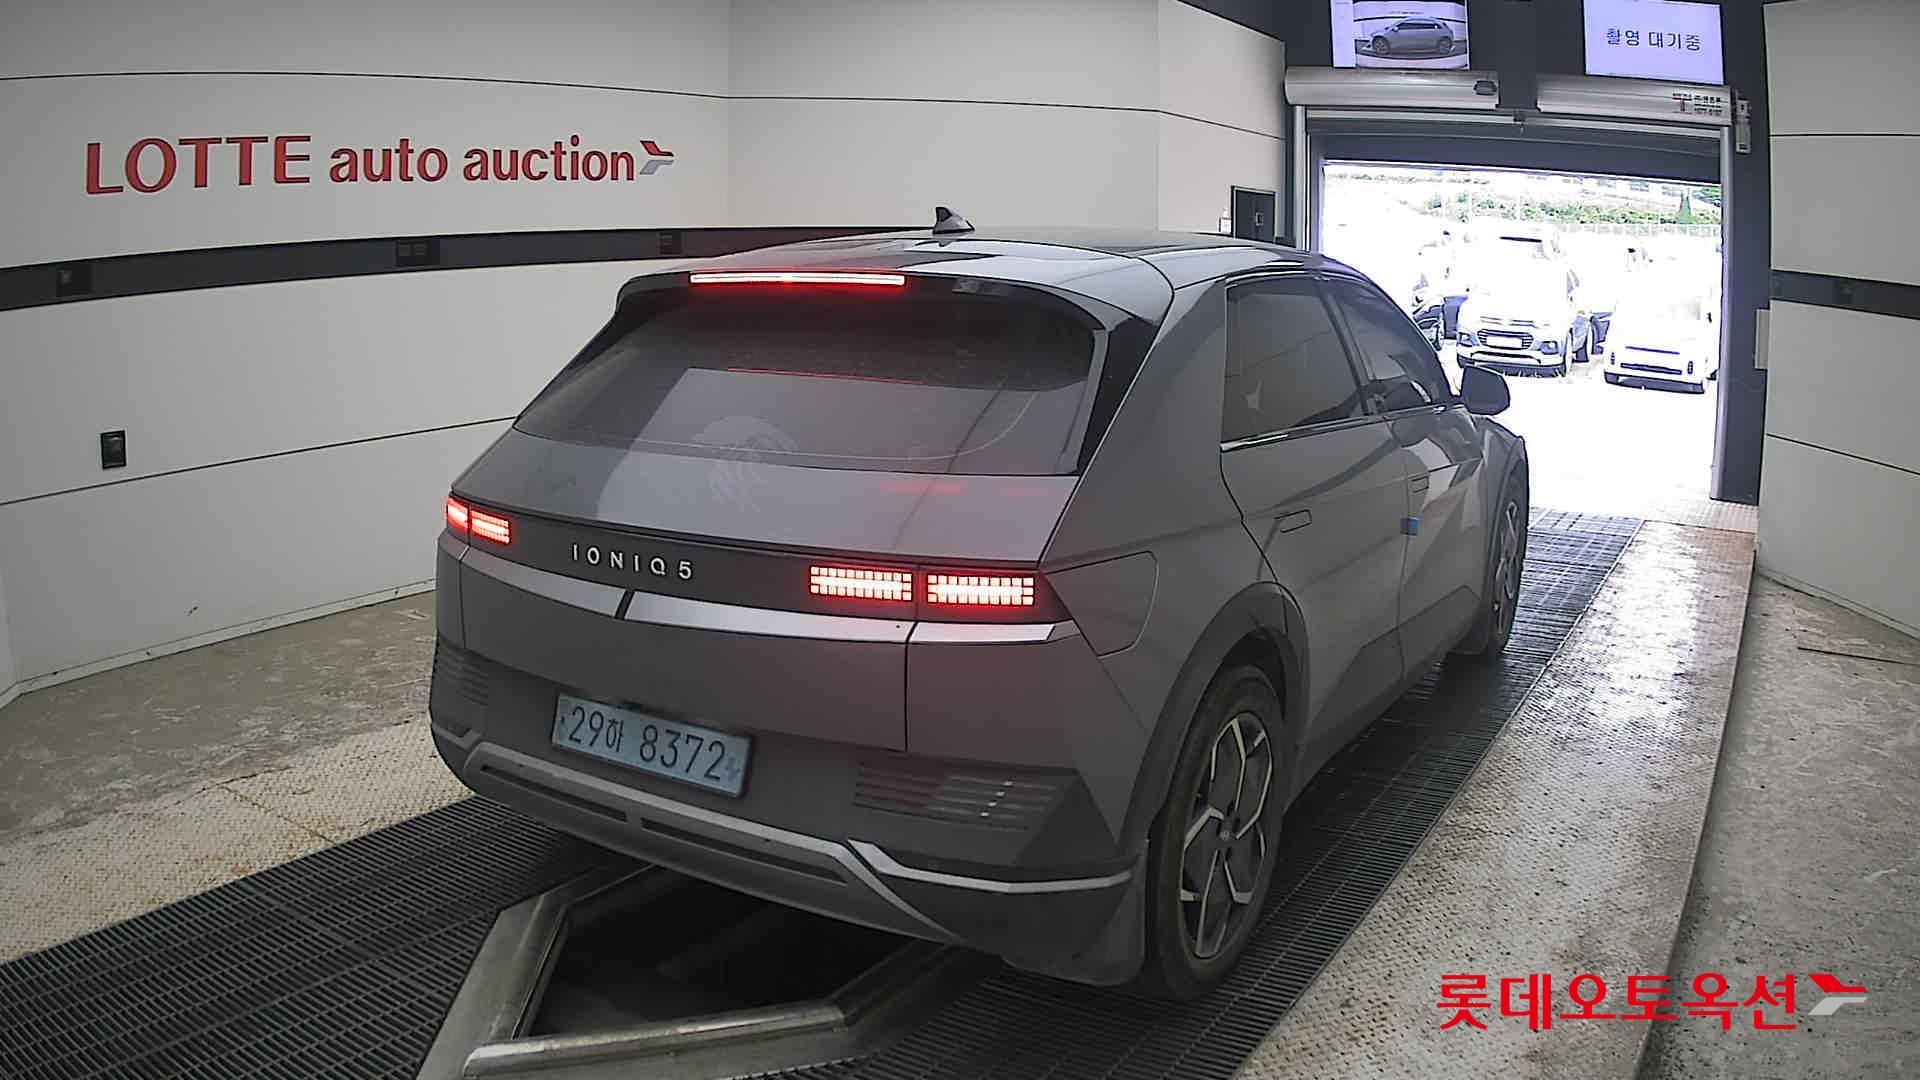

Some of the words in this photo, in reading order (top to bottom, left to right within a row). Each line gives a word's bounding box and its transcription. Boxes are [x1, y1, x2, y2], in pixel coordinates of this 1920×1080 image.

[1606, 28, 1640, 47] 촬영
[1648, 31, 1700, 51] 대기중
[86, 135, 311, 195] LOTTE
[330, 137, 448, 183] auto
[463, 135, 635, 183] auction
[572, 543, 667, 576] IONIQ
[568, 705, 625, 753] 29하
[638, 724, 727, 781] 8372
